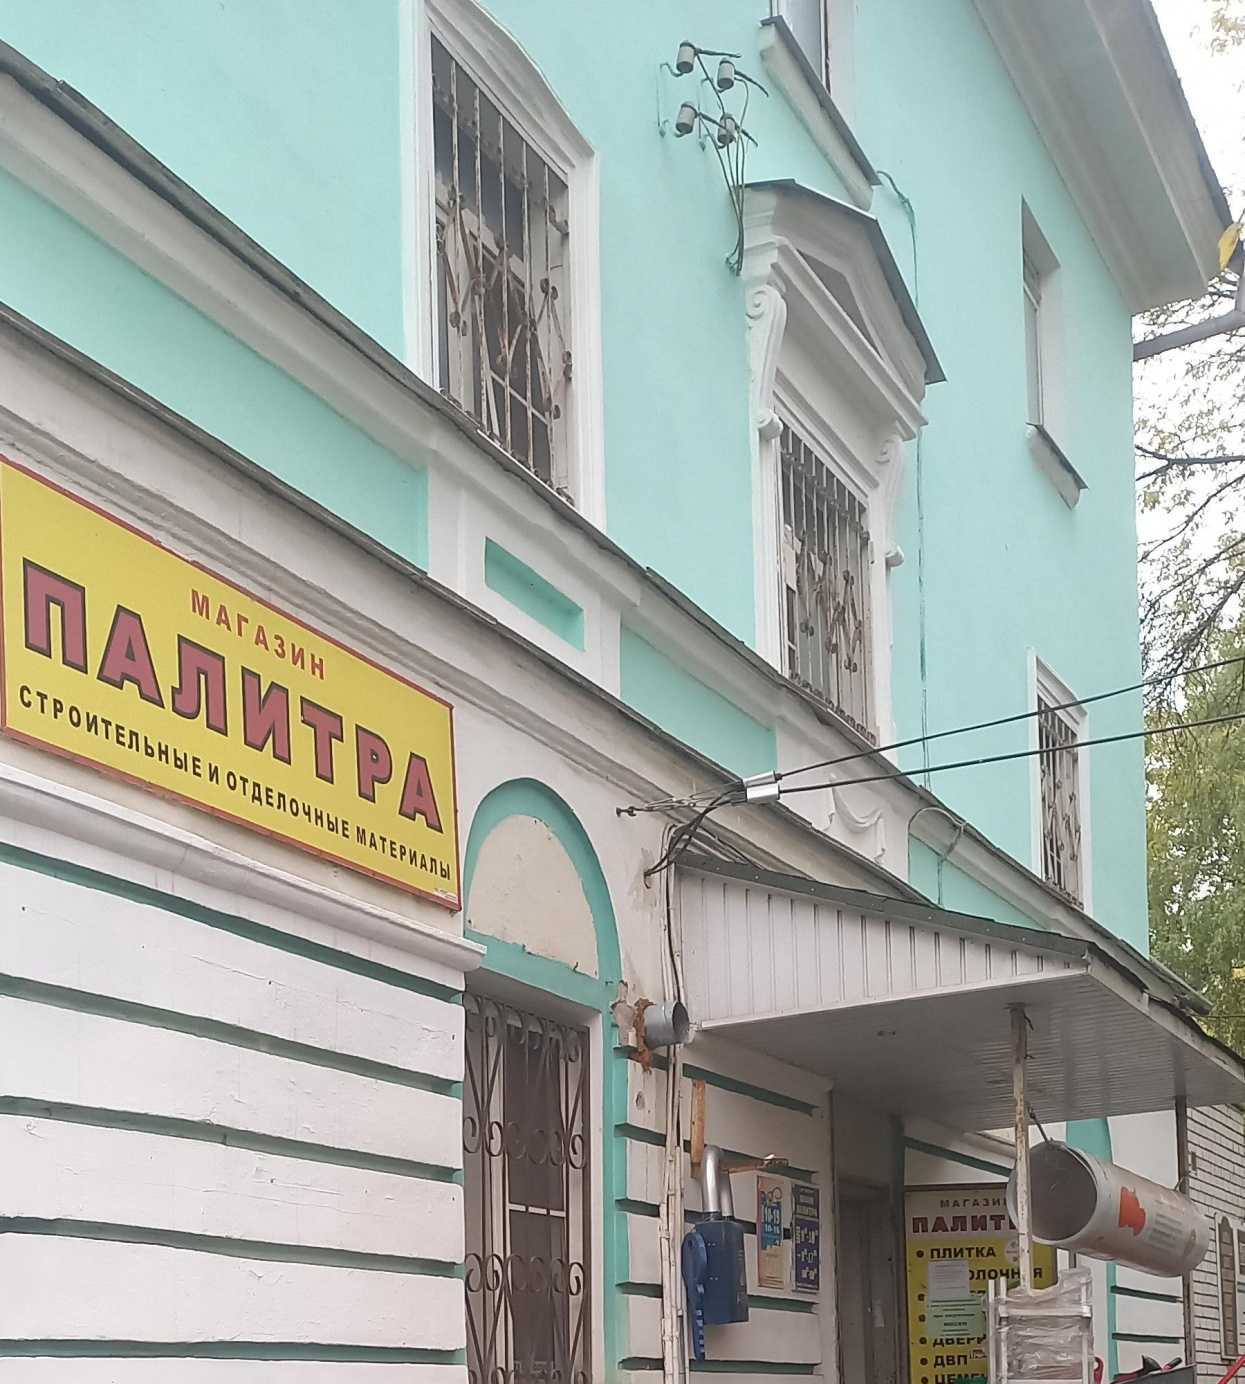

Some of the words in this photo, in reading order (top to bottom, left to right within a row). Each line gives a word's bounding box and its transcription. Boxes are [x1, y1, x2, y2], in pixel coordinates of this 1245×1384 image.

[191, 588, 325, 681] МАГАЗИН
[22, 557, 444, 834] ПАЛИТРА
[19, 685, 201, 778] СТРОИТЕЛЬНЫЕ
[208, 763, 219, 785] И
[226, 771, 350, 839] ОТДЕЛОЧНЫЕ
[356, 825, 450, 881] МАТЕРИАЛЫ
[912, 1214, 1017, 1233] ПАЛИТ
[930, 1246, 997, 1259] ПЛИТКА
[934, 1355, 968, 1368] ДВП
